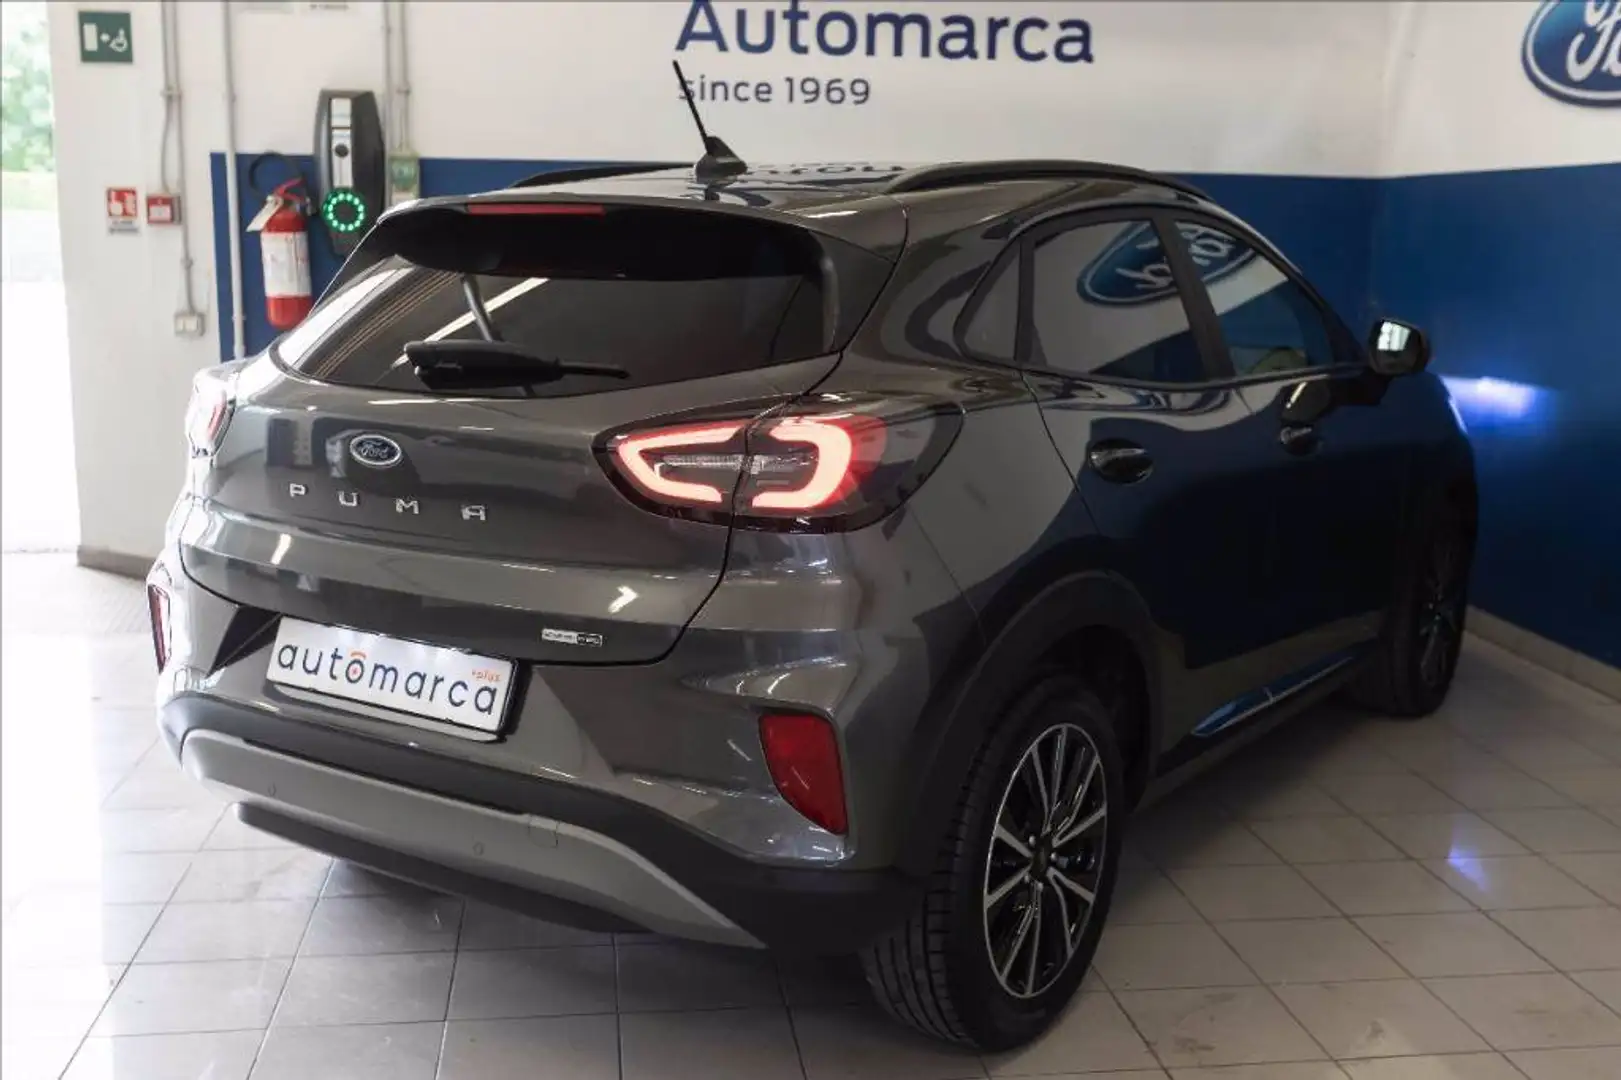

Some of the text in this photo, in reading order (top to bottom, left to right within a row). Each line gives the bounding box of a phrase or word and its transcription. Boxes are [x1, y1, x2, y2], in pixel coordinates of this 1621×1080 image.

[675, 1, 1094, 63] Automarca
[678, 74, 871, 105] since 1969
[290, 483, 487, 521] PUMA
